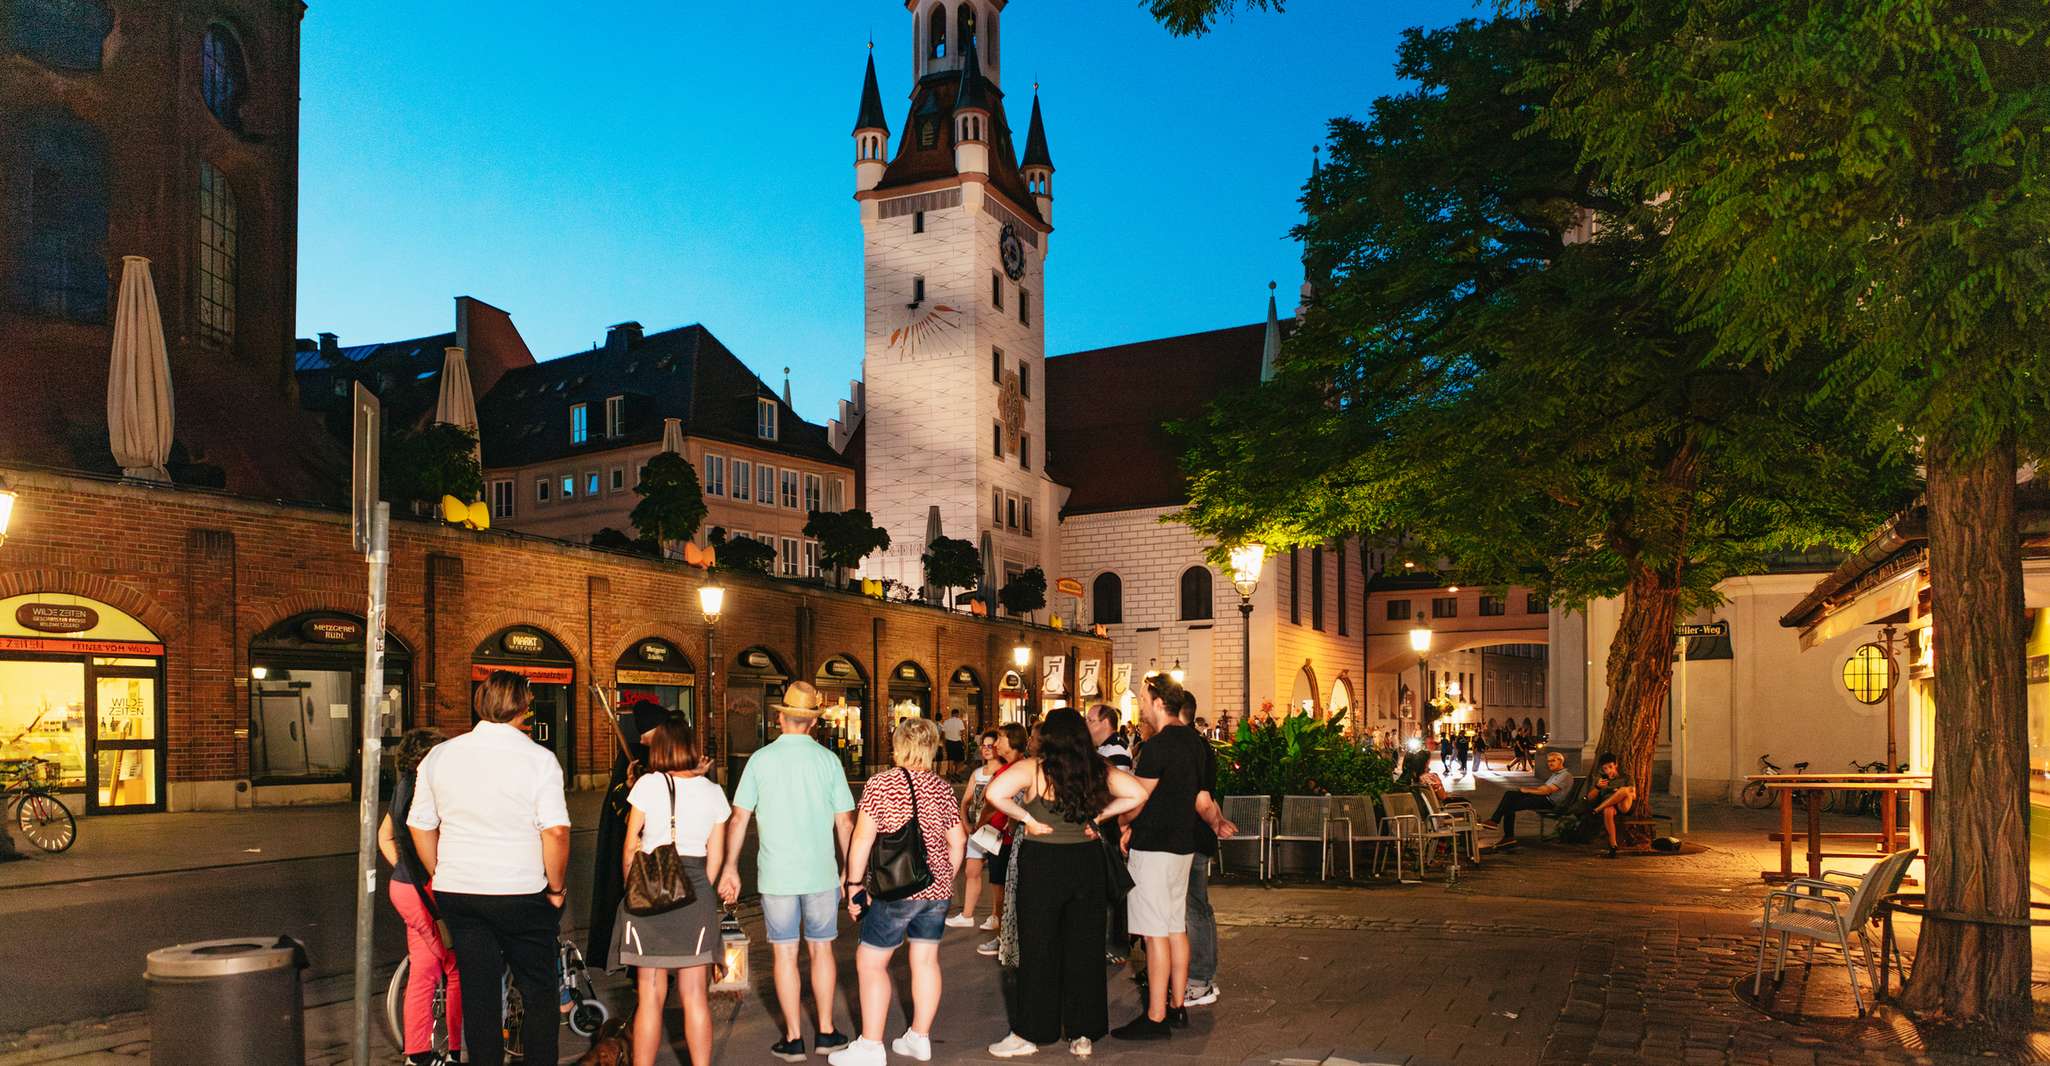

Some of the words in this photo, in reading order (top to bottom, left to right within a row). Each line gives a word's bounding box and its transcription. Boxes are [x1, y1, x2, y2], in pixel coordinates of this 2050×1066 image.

[32, 607, 57, 616] WILDE
[59, 609, 87, 618] ZEITEN
[6, 639, 44, 649] ZEITEN
[512, 635, 538, 647] MARKT
[127, 645, 151, 654] WILD
[112, 697, 144, 707] WILDE
[109, 707, 144, 716] ZEITEN
